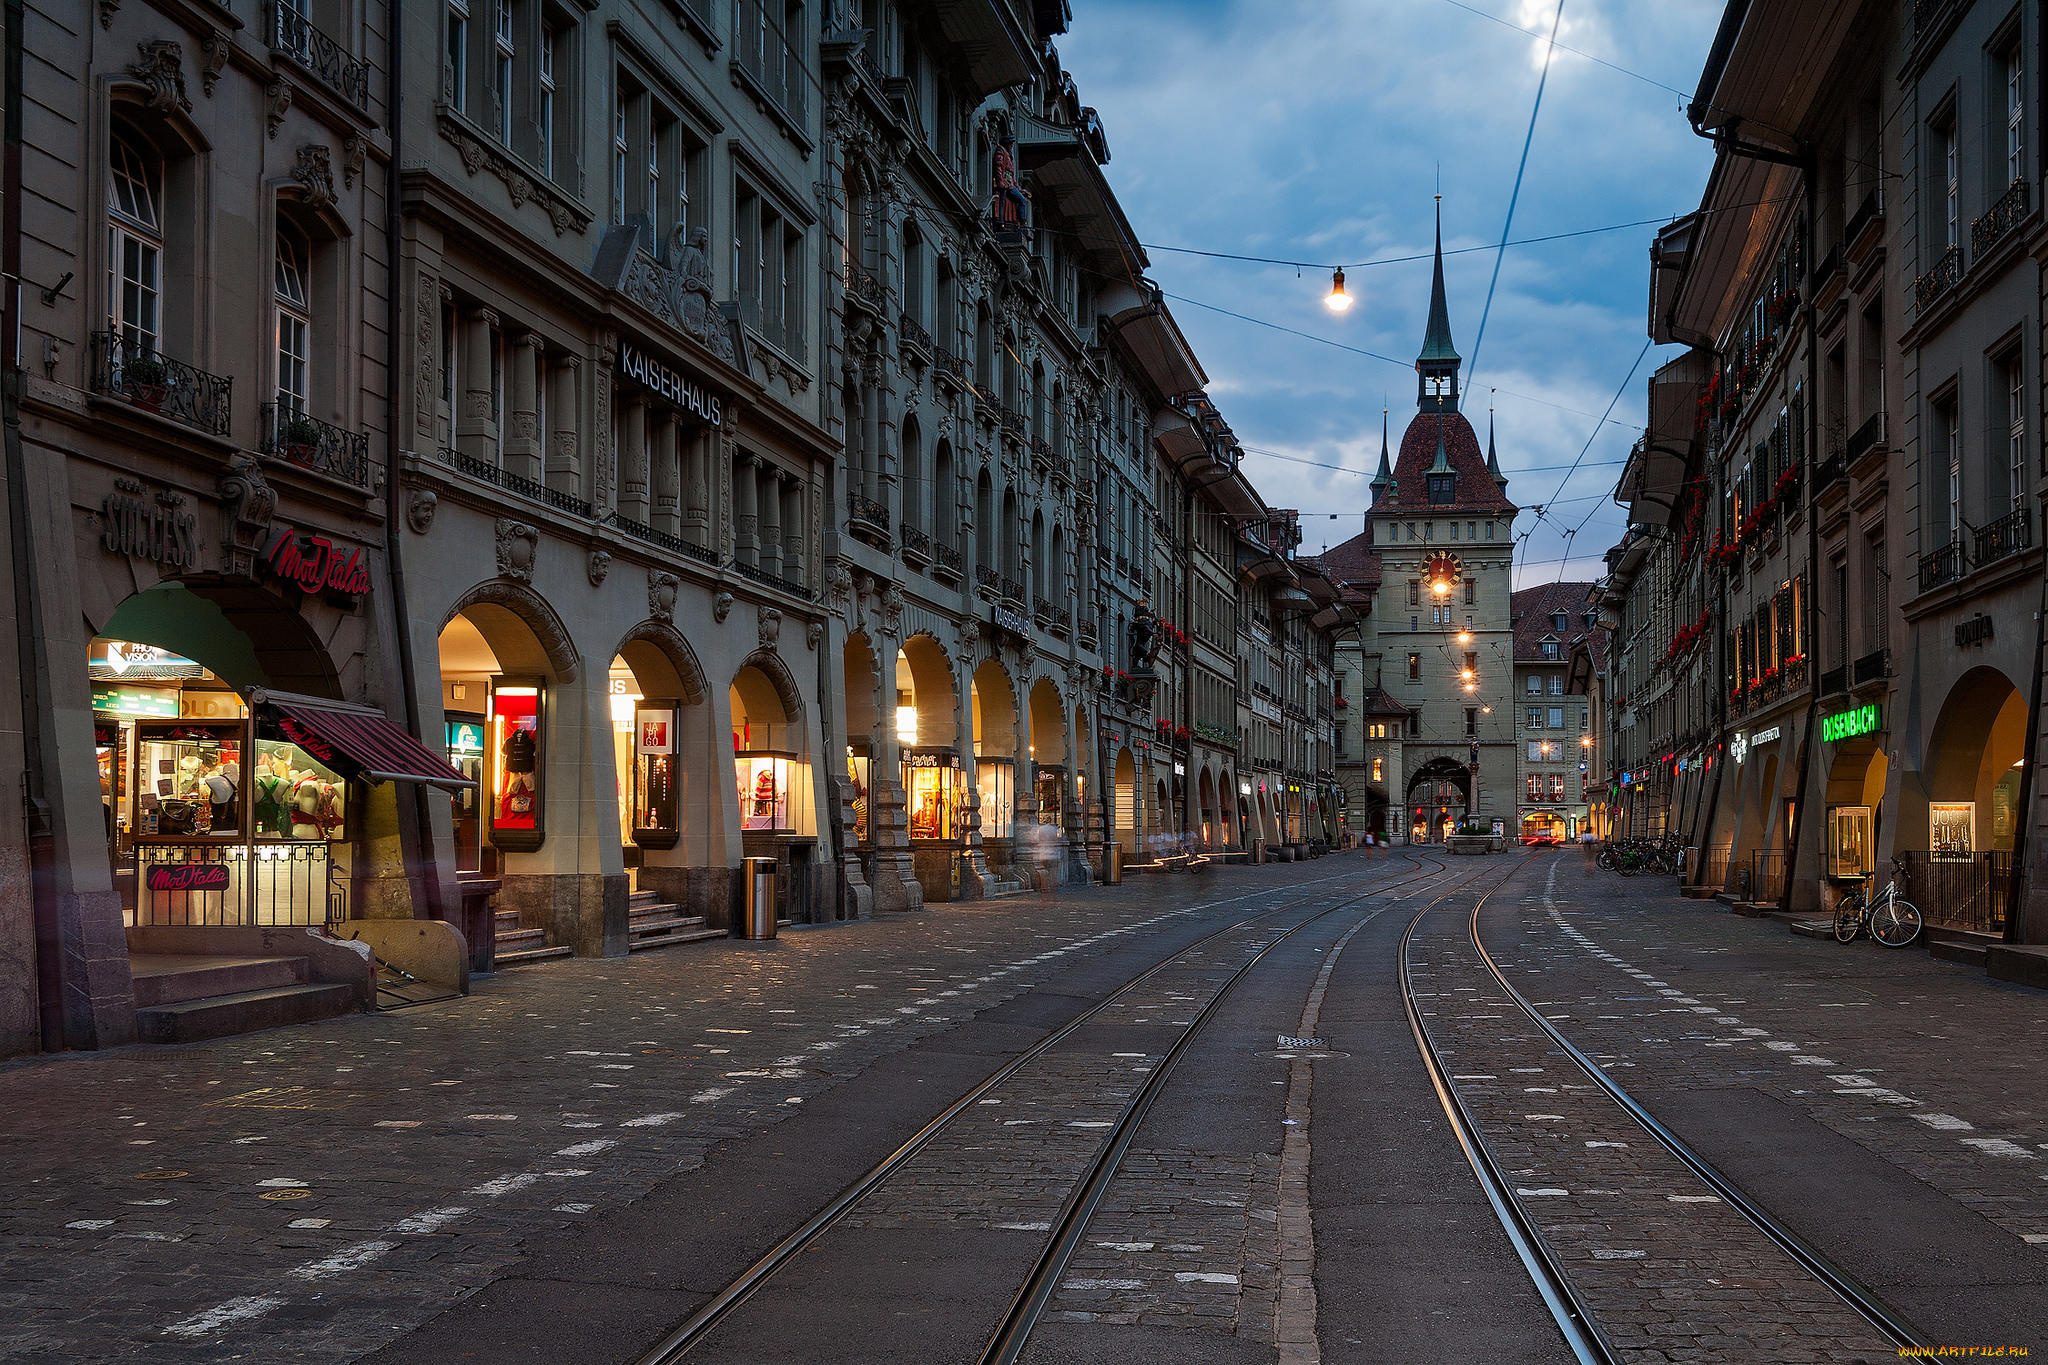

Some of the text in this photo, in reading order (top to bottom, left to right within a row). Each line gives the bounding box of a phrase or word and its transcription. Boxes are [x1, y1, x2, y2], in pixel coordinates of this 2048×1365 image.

[623, 342, 721, 426] KAISERHAUS
[125, 652, 157, 662] VISION
[1823, 704, 1876, 742] DOSENBACH
